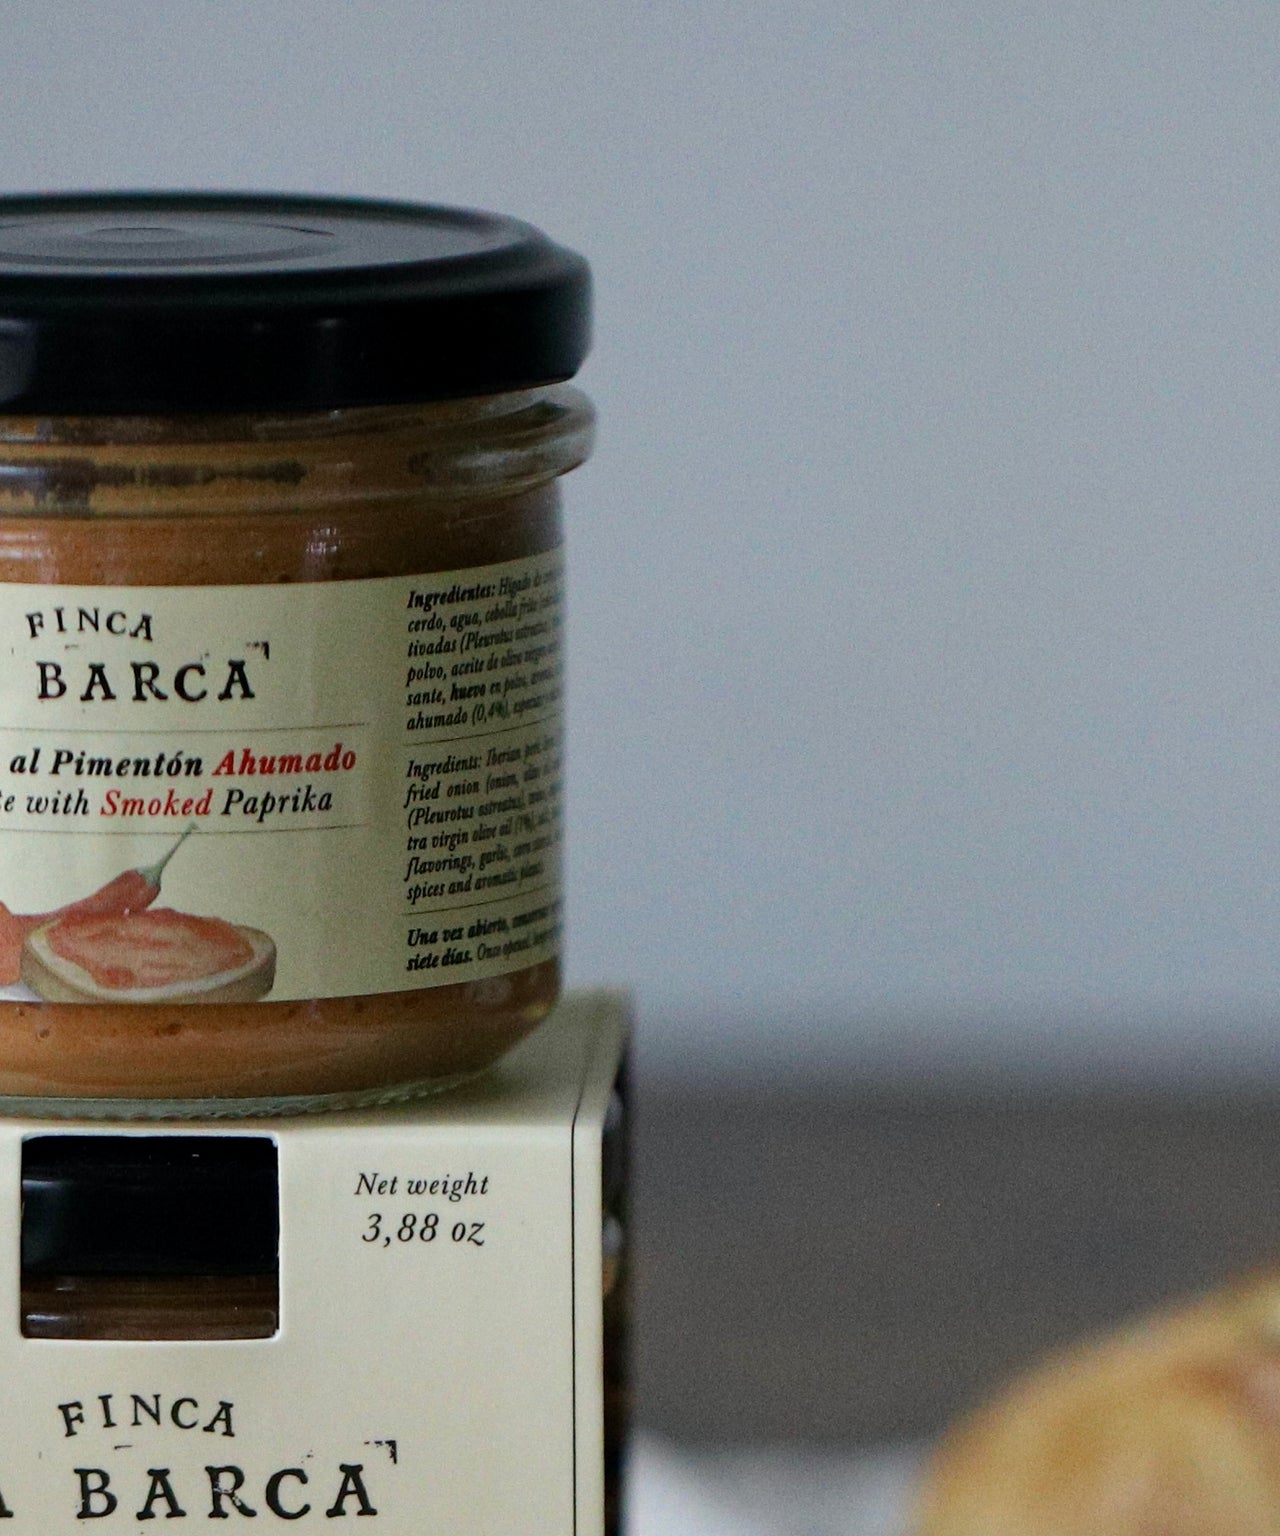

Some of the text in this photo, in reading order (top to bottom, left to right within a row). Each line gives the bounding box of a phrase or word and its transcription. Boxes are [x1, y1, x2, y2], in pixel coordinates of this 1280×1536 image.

[407, 584, 496, 612] Ingredientes:
[25, 607, 153, 641] FINCA
[407, 612, 446, 633] cerdo,
[450, 612, 482, 632] agua,
[407, 636, 456, 658] tivadas
[36, 657, 256, 702] BARCA
[405, 661, 447, 687] polvo,
[406, 687, 446, 708] sante,
[406, 706, 468, 731] ahumado
[9, 748, 40, 774] al
[50, 748, 203, 777] Pimentón
[212, 743, 357, 777] Ahumado
[406, 755, 482, 782] Ingredients:
[26, 788, 89, 816] with
[100, 788, 213, 817] Smoked
[221, 785, 332, 823] Paprika
[403, 781, 440, 809] fried
[447, 780, 480, 798] onion
[407, 805, 474, 830] (Pleurotus
[407, 835, 427, 851] tra
[431, 830, 469, 852] virgin
[404, 855, 475, 882] flavorings,
[406, 882, 445, 906] spices
[448, 875, 473, 893] and
[407, 928, 438, 947] Una
[443, 926, 463, 943] vez
[406, 953, 439, 972] siete
[354, 1172, 489, 1203] Net weight
[361, 1213, 486, 1248] 3,88 oz
[57, 1394, 237, 1438] FINCA
[73, 1463, 378, 1521] BARCA
